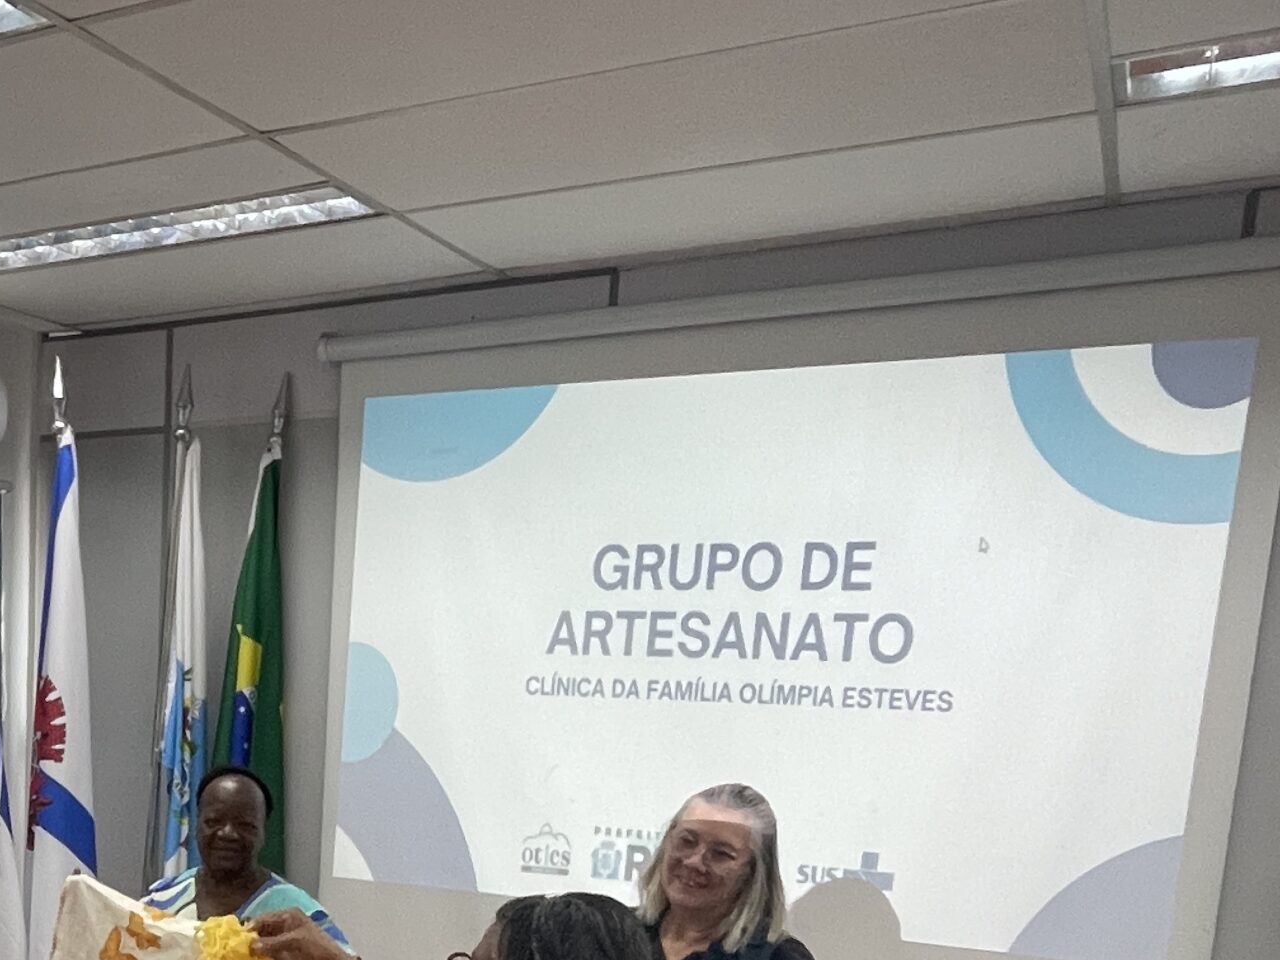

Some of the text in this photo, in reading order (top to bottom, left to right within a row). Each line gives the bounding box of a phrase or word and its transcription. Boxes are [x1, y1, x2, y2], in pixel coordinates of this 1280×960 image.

[593, 541, 877, 592] GRUPO DE
[545, 610, 914, 664] ARTESANATO
[525, 671, 954, 712] CLÍNICA DA FAMÍLIA OLÍMPIA ESTEVES
